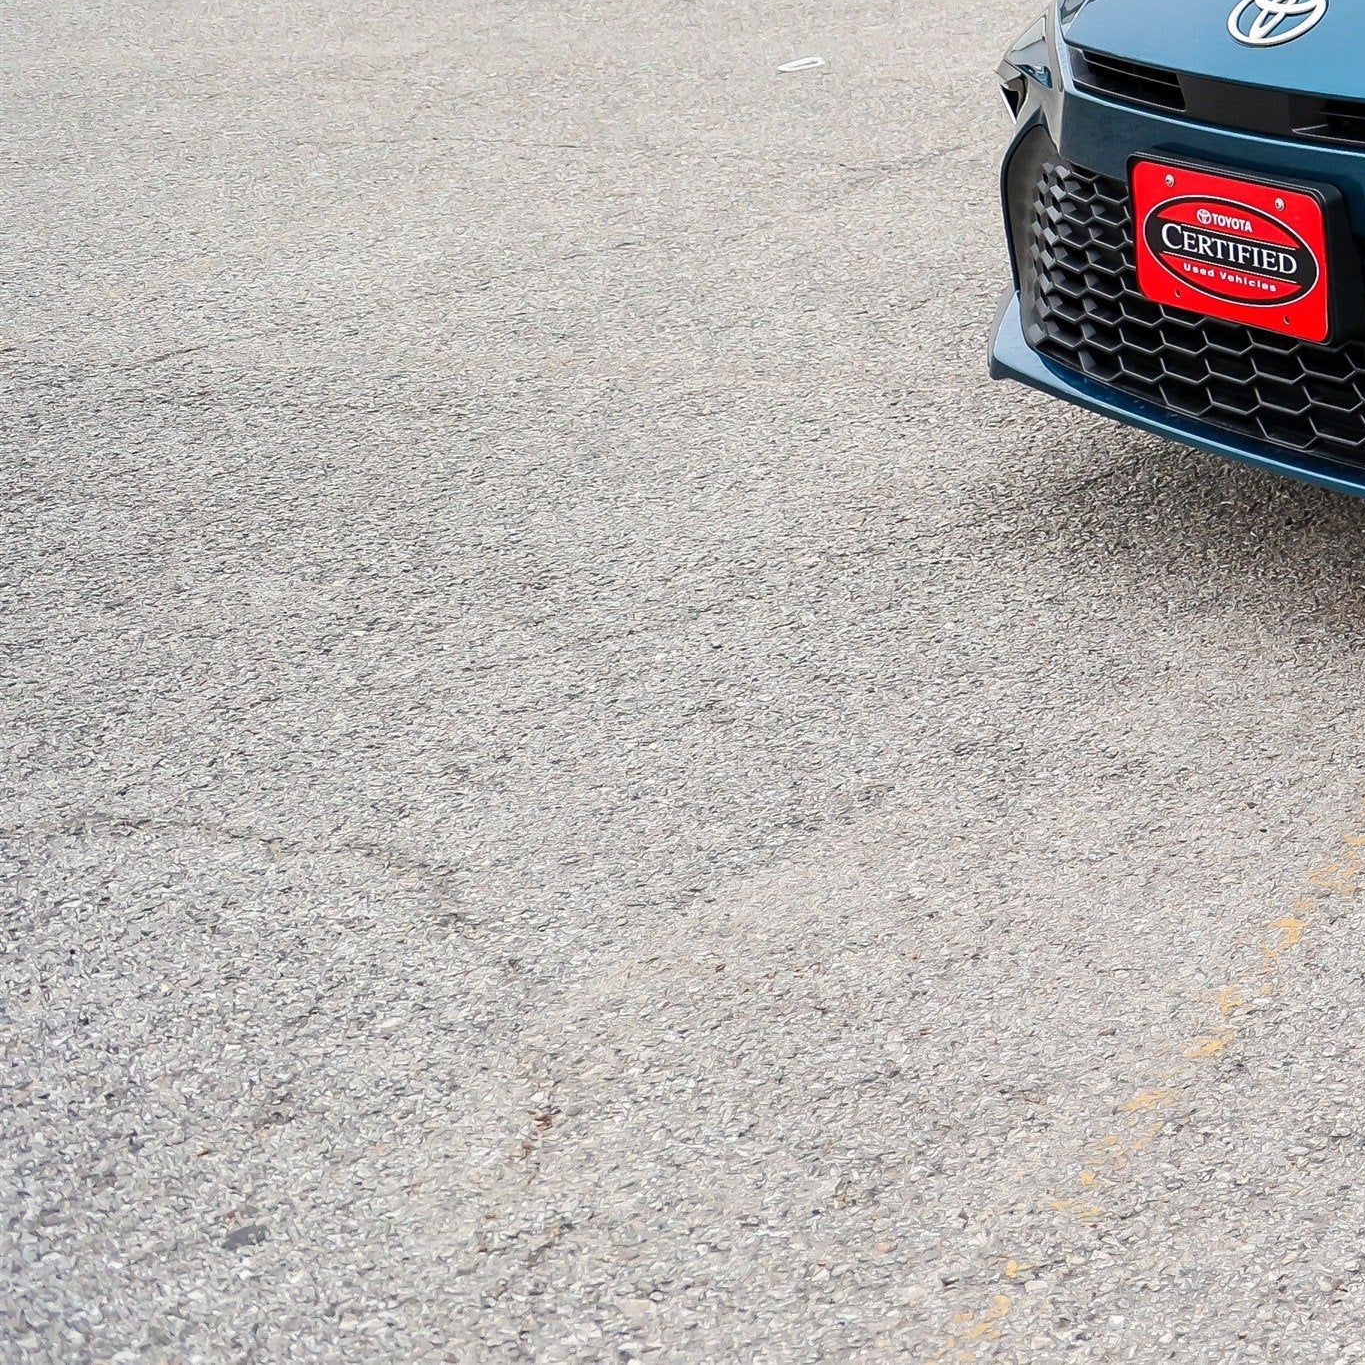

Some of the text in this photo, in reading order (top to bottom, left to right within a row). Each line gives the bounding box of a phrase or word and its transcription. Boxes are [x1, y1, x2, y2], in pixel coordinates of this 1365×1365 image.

[1212, 213, 1253, 232] TOYOTA
[1162, 223, 1297, 274] CERTIFIED
[1183, 263, 1277, 292] Used Vehicles
